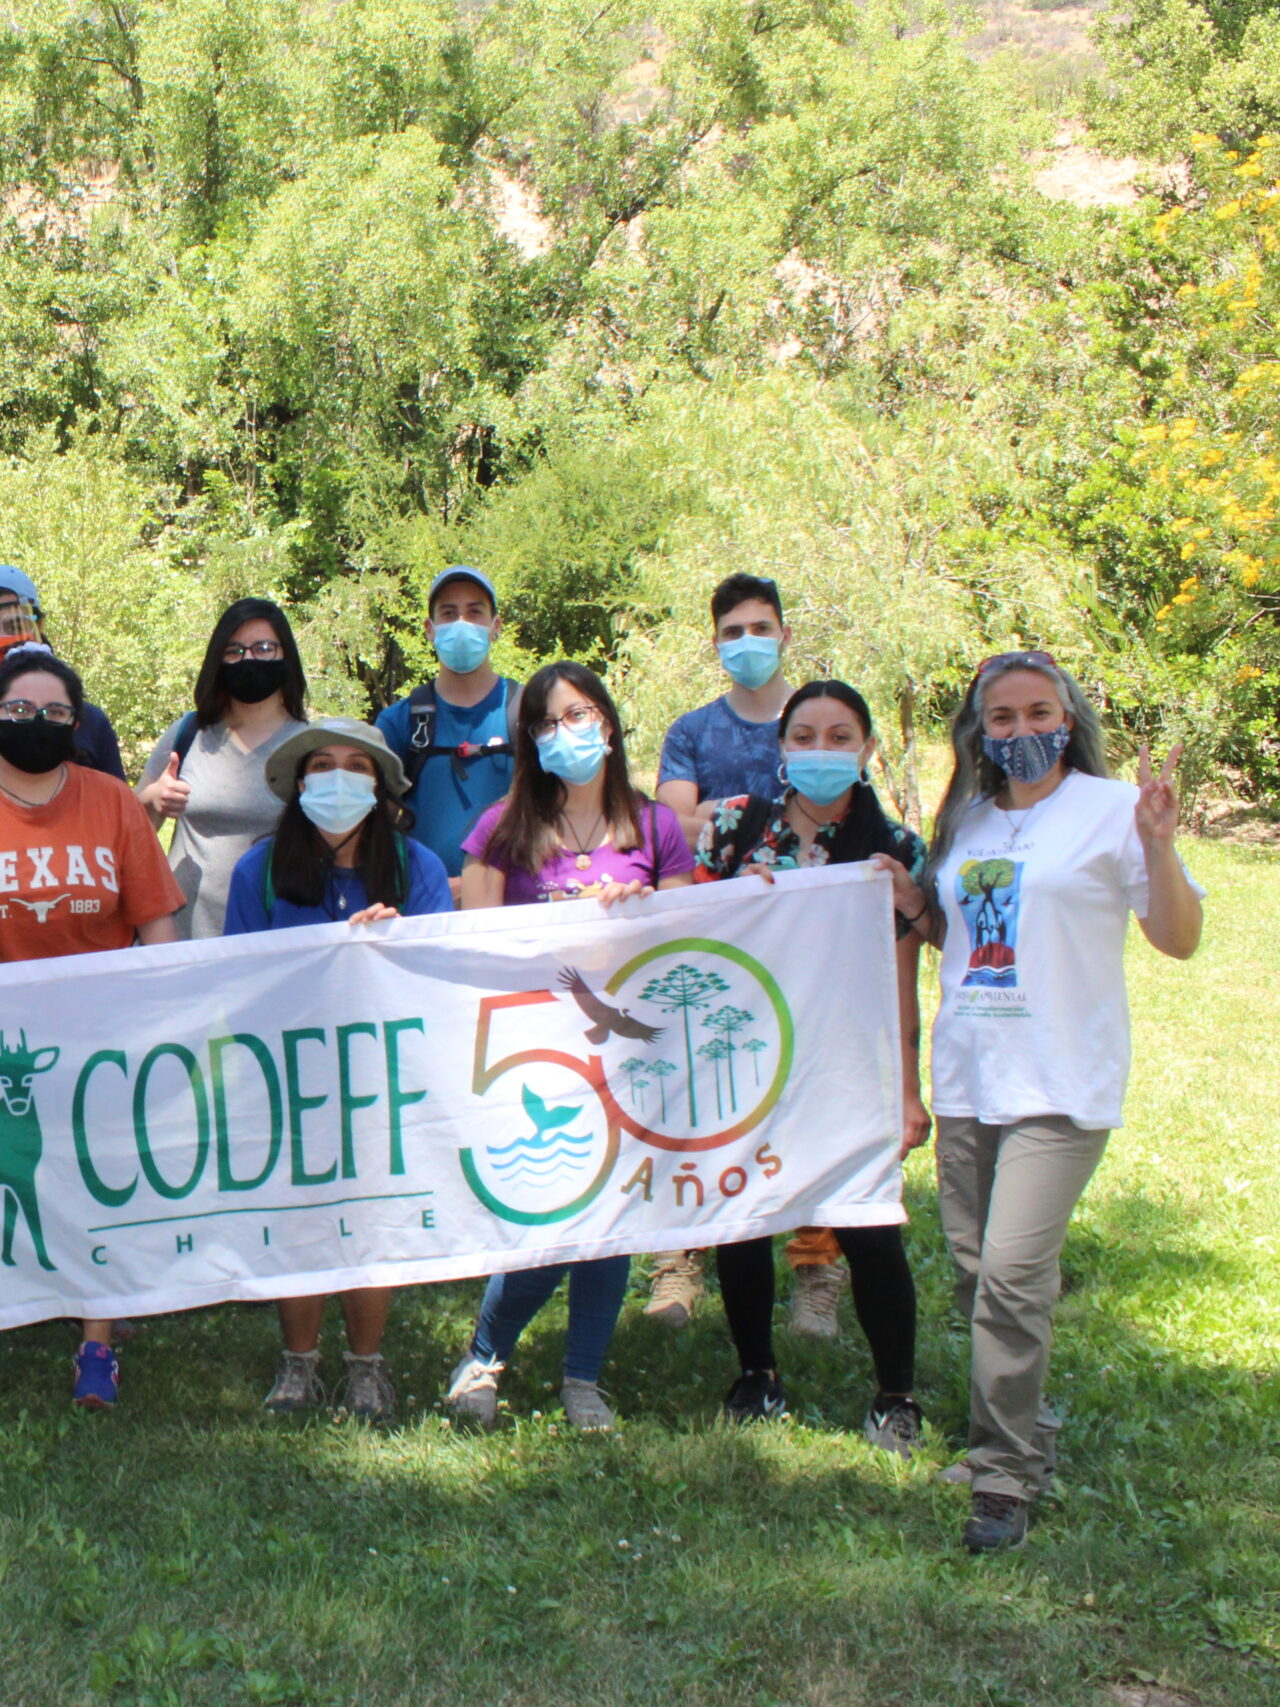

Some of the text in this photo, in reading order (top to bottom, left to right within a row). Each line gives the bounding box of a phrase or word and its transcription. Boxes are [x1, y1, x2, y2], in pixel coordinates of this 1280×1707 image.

[70, 899, 101, 914] 1883
[71, 1016, 428, 1208] CODEFF
[90, 1209, 436, 1266] CHILE
